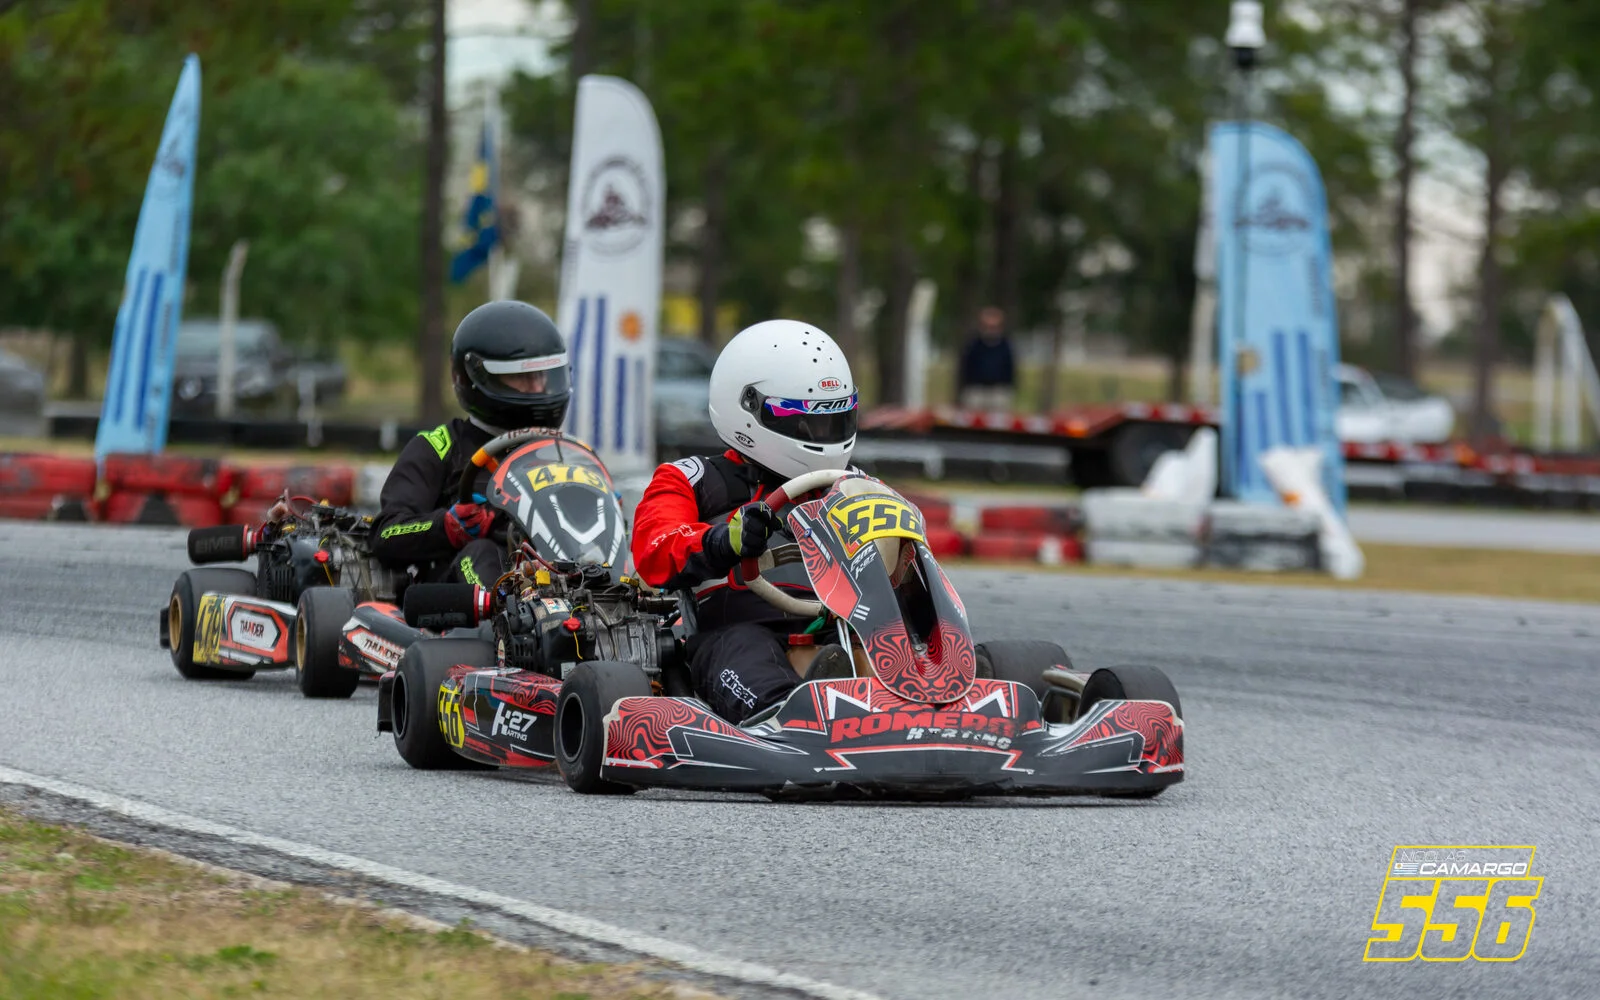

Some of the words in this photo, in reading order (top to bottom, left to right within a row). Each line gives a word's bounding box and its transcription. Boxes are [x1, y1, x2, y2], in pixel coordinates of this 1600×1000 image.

[820, 380, 840, 388] BELL
[810, 398, 849, 412] RM
[534, 466, 605, 489] 479
[845, 503, 923, 543] 556
[240, 619, 264, 639] THUNDER
[830, 711, 1015, 743] ROMERO
